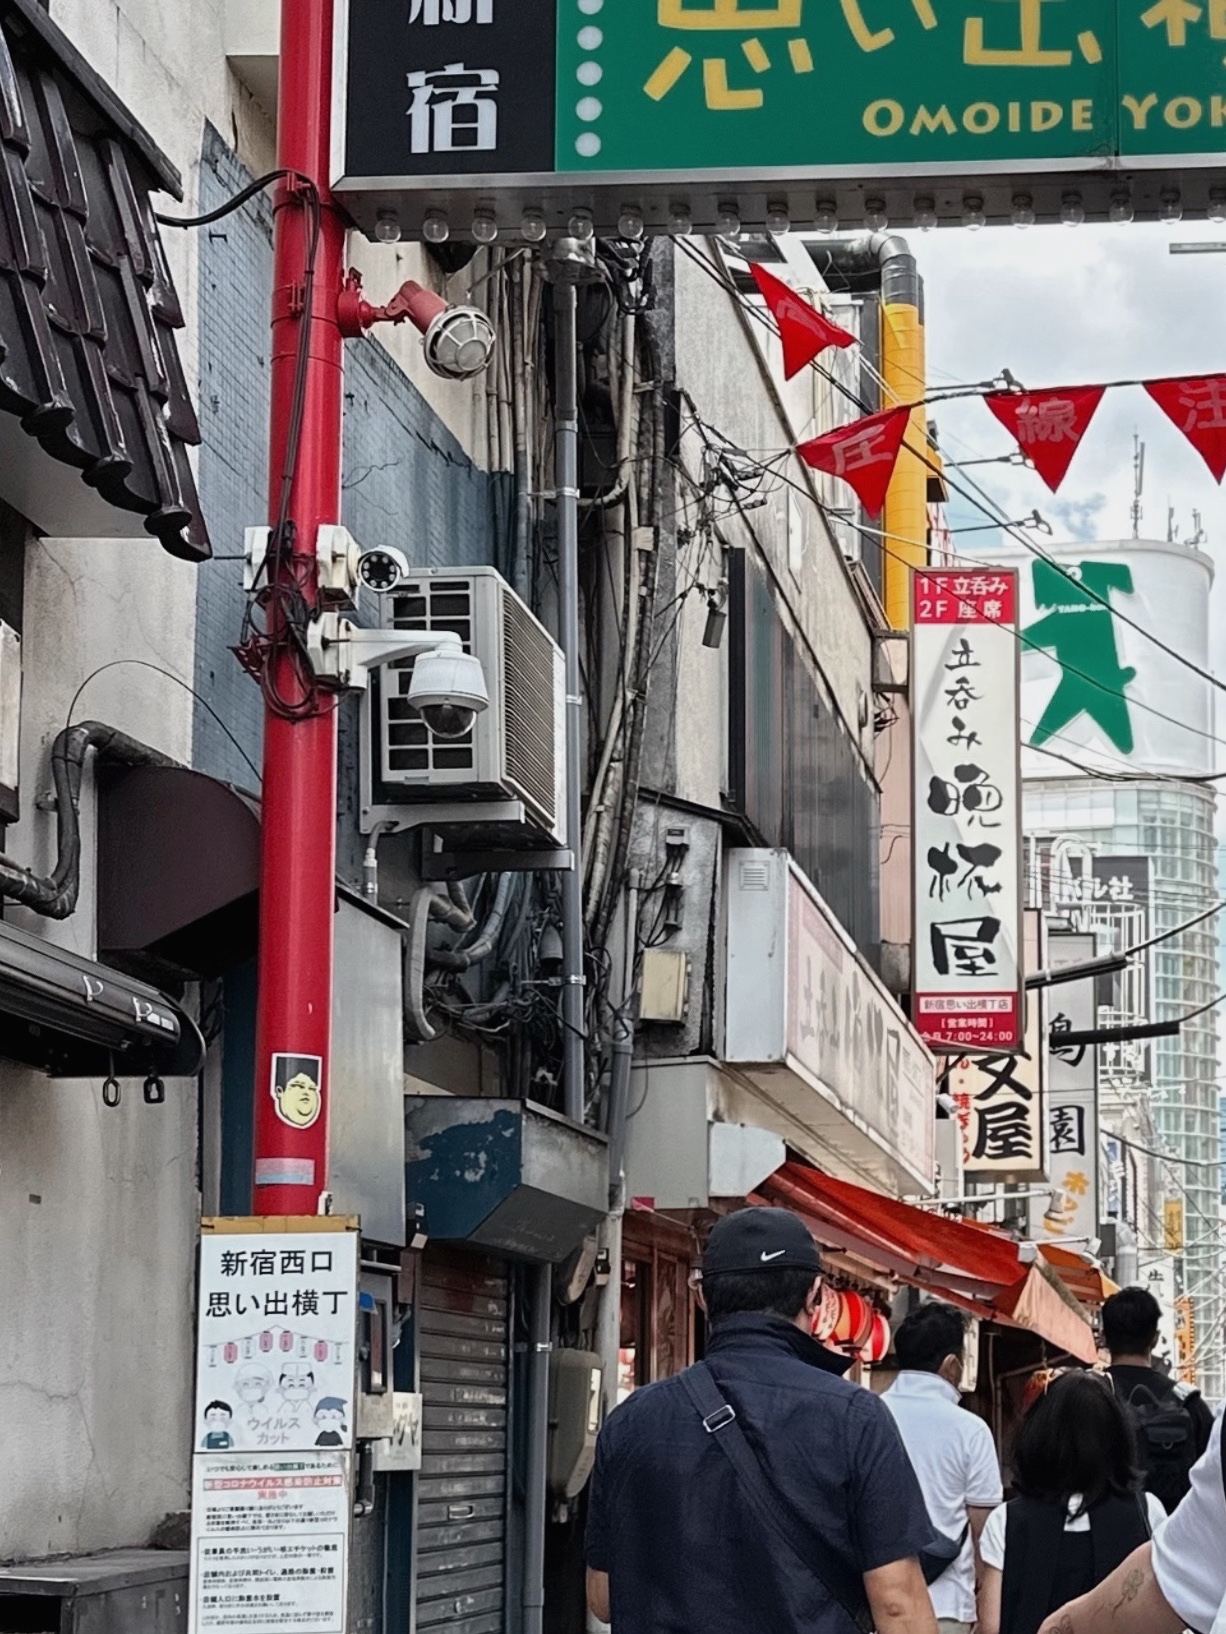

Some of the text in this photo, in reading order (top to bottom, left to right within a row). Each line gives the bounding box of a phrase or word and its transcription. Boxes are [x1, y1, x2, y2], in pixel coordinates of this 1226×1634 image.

[407, 0, 500, 153] 宿
[862, 98, 1095, 137] OMOIDE
[920, 576, 949, 595] 1F
[919, 600, 948, 618] 2F
[220, 1249, 333, 1277] 新宿西口
[205, 1289, 349, 1317] 思い出横丁
[247, 1416, 301, 1431] ウイルス
[256, 1431, 290, 1446] カット
